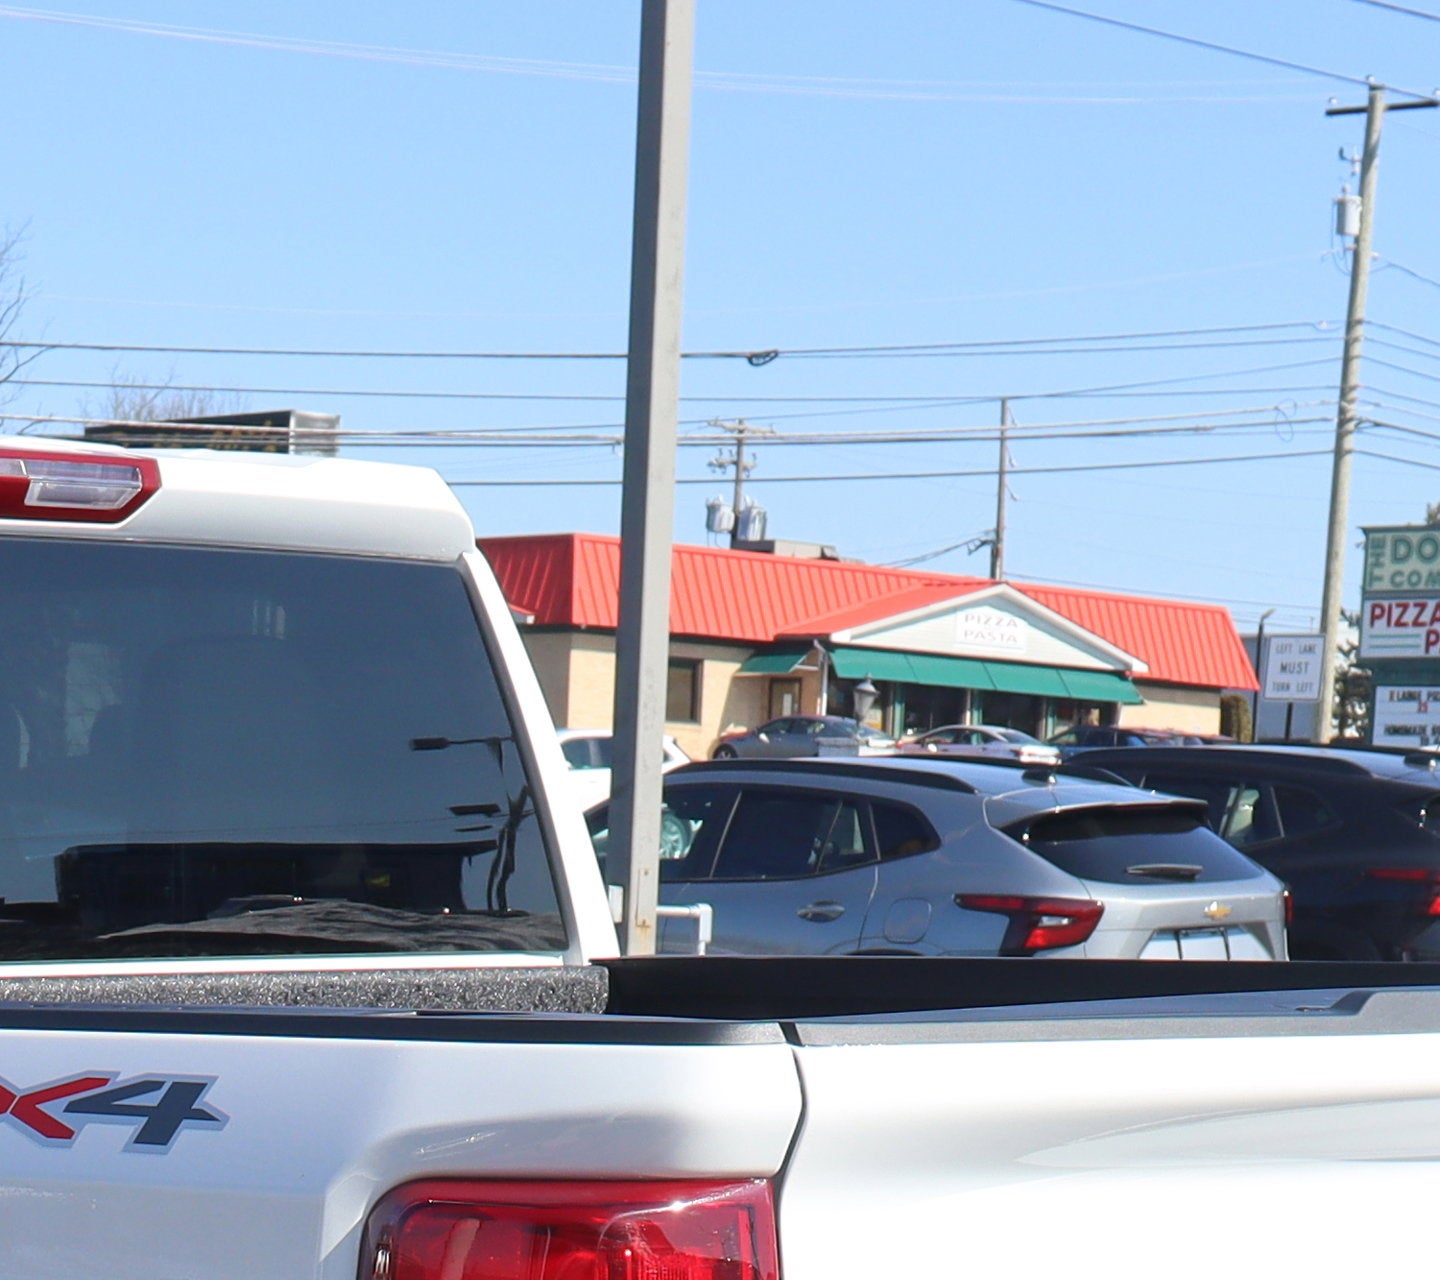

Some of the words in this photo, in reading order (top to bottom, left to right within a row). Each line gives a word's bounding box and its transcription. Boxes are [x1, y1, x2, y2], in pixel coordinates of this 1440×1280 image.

[1370, 535, 1386, 586] THE
[965, 614, 1018, 628] PIZZA
[964, 629, 1018, 644] PASTA
[1280, 661, 1309, 674] MUST
